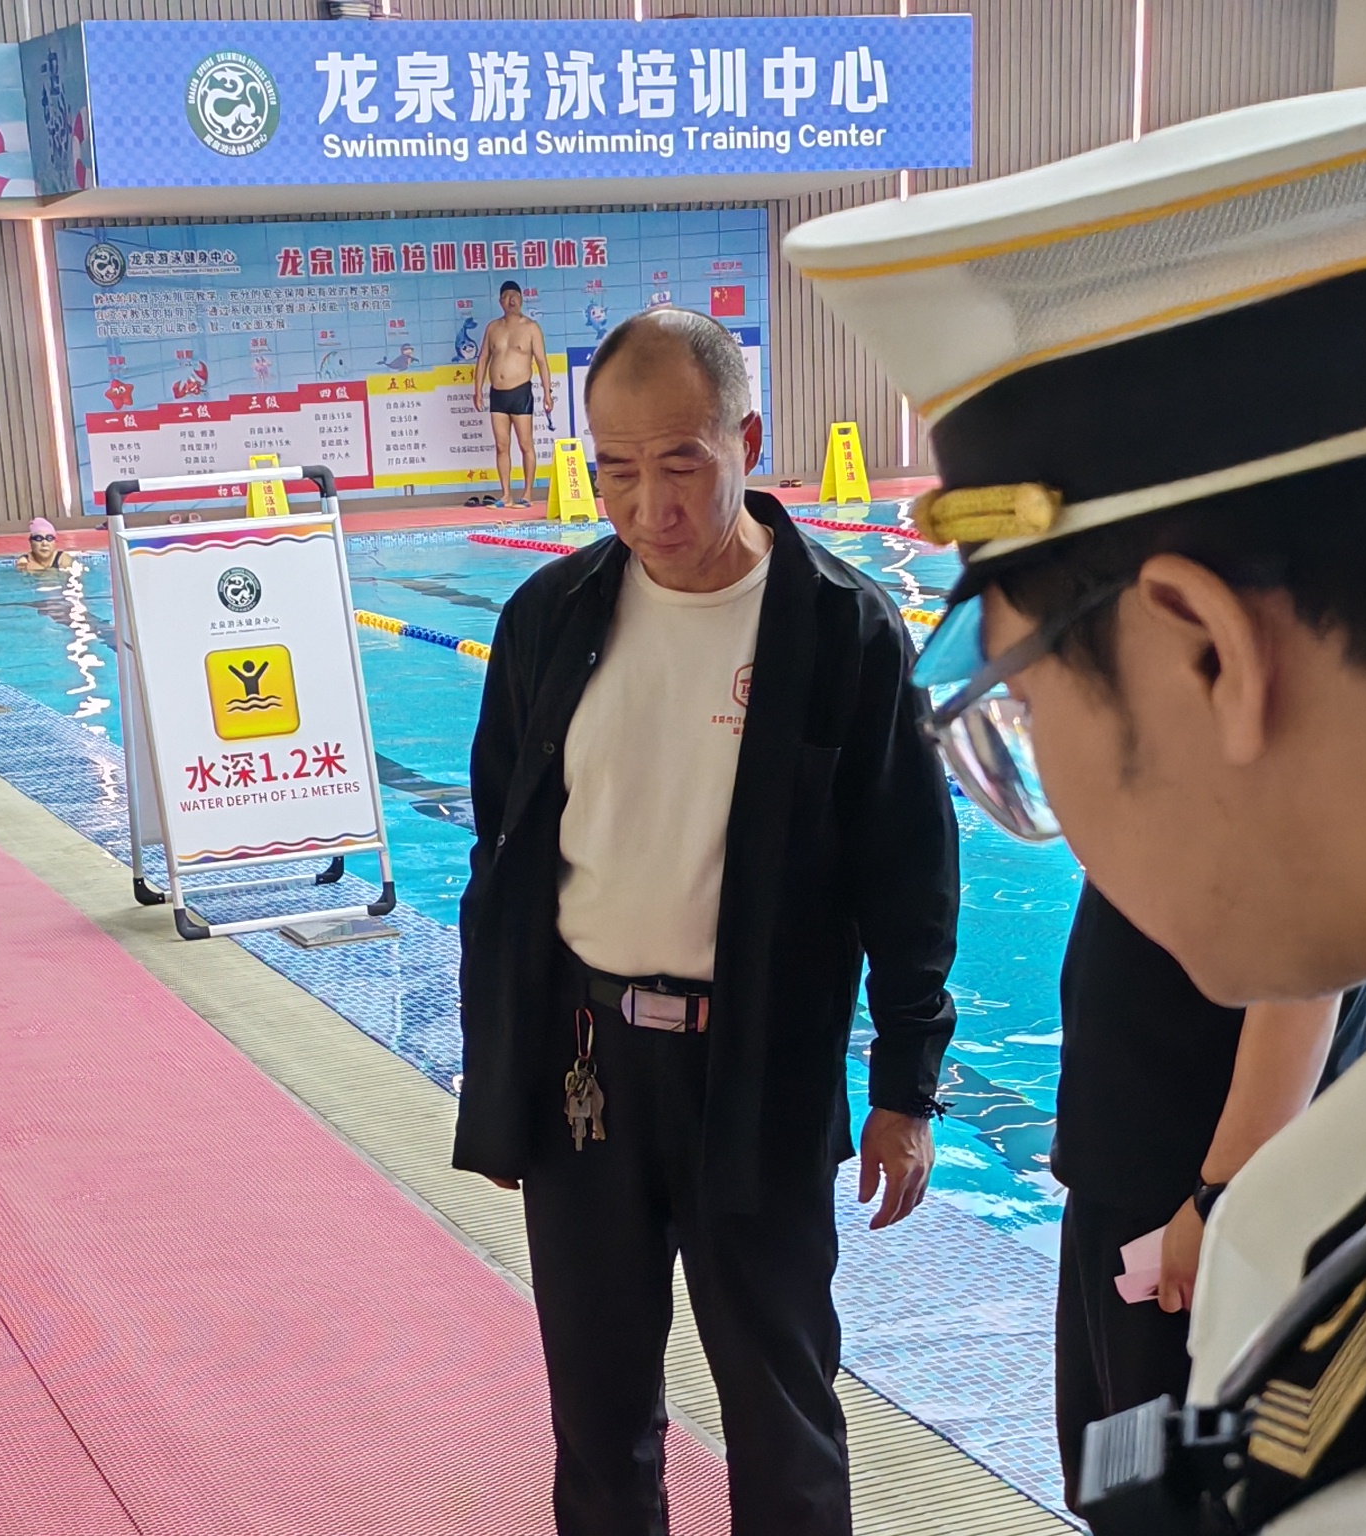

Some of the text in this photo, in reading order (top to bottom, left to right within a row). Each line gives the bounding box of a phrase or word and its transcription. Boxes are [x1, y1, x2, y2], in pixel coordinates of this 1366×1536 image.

[316, 45, 888, 125] 龙泉游泳培训中心
[323, 123, 887, 161] Swimming and Swimming Training Center
[277, 237, 607, 278] 龙泉游泳培训俱乐部体系
[318, 385, 350, 400] 四级
[387, 377, 417, 391] 五级
[178, 404, 211, 419] 二级
[248, 395, 280, 410] 三级
[105, 414, 138, 428] 一级
[566, 455, 581, 499] 快速泳道
[185, 741, 348, 793] 水深1.2米
[180, 781, 361, 813] WATER DEPTH OF 1.2 METERS
